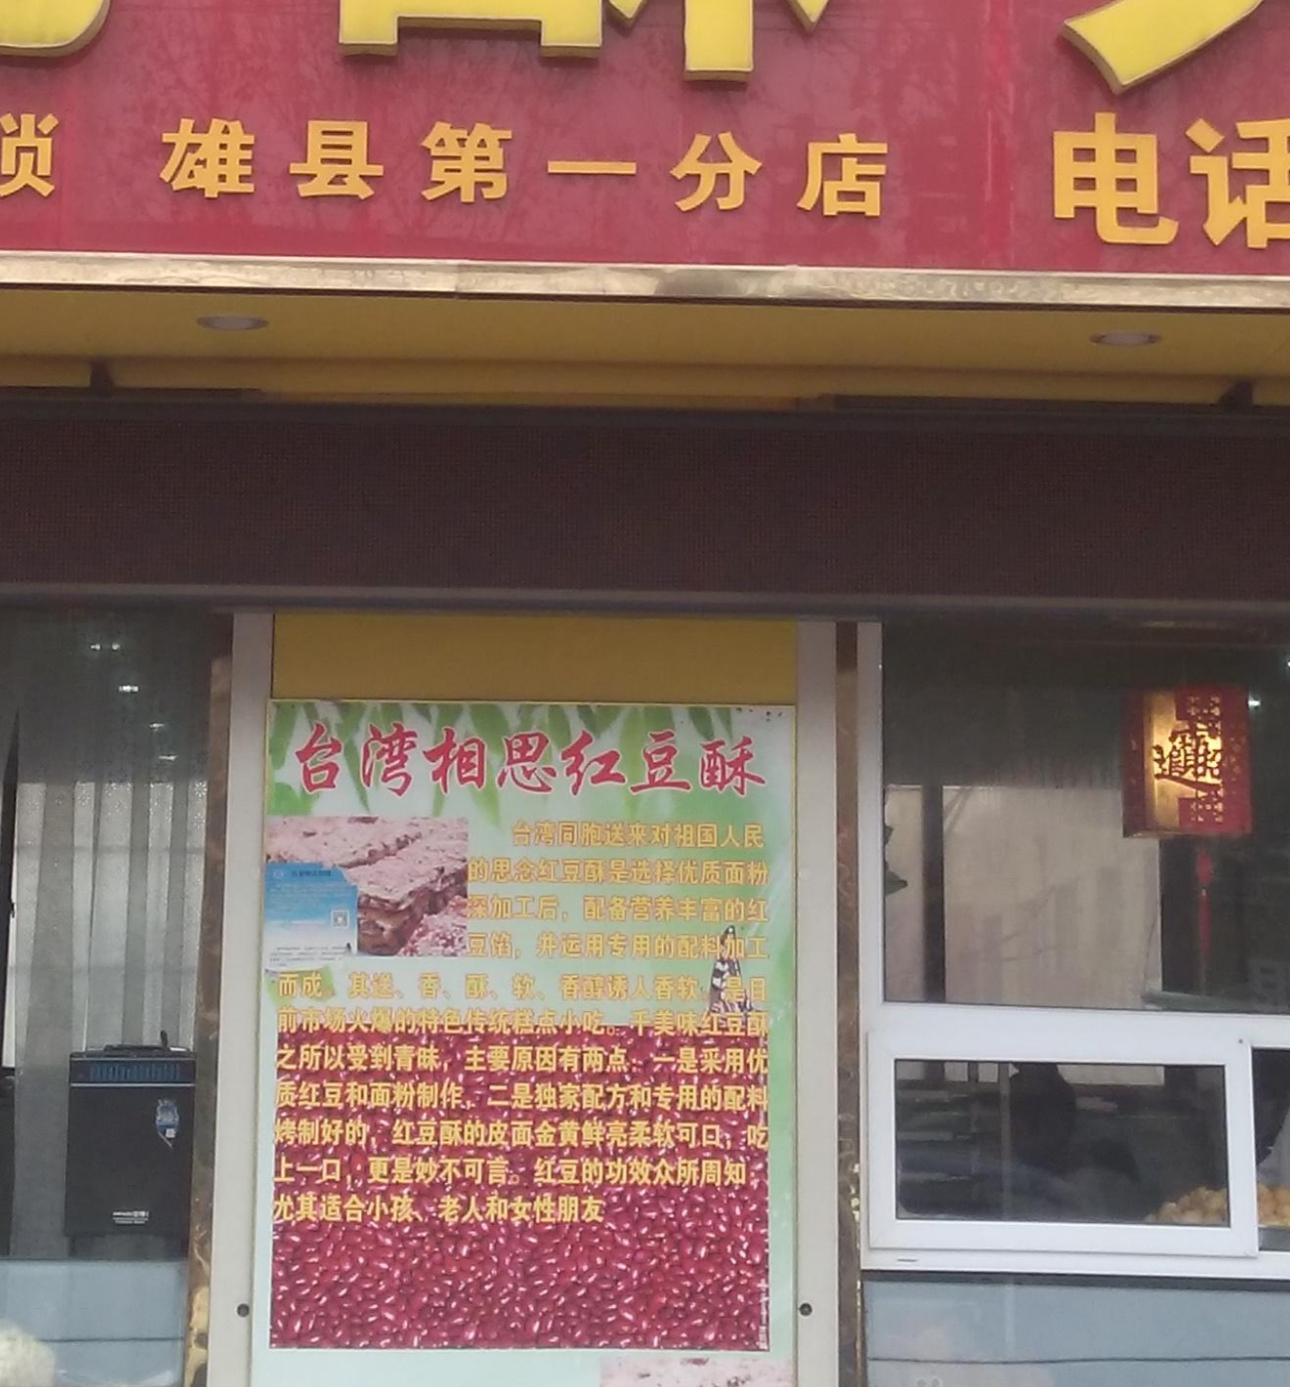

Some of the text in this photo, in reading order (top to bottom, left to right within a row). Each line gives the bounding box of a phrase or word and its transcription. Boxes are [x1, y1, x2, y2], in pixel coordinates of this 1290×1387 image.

[158, 116, 889, 218] 雄县第一分店
[295, 721, 766, 797] 台湾相思红豆酥
[512, 820, 765, 849] 台湾同胞送来对祖国人民
